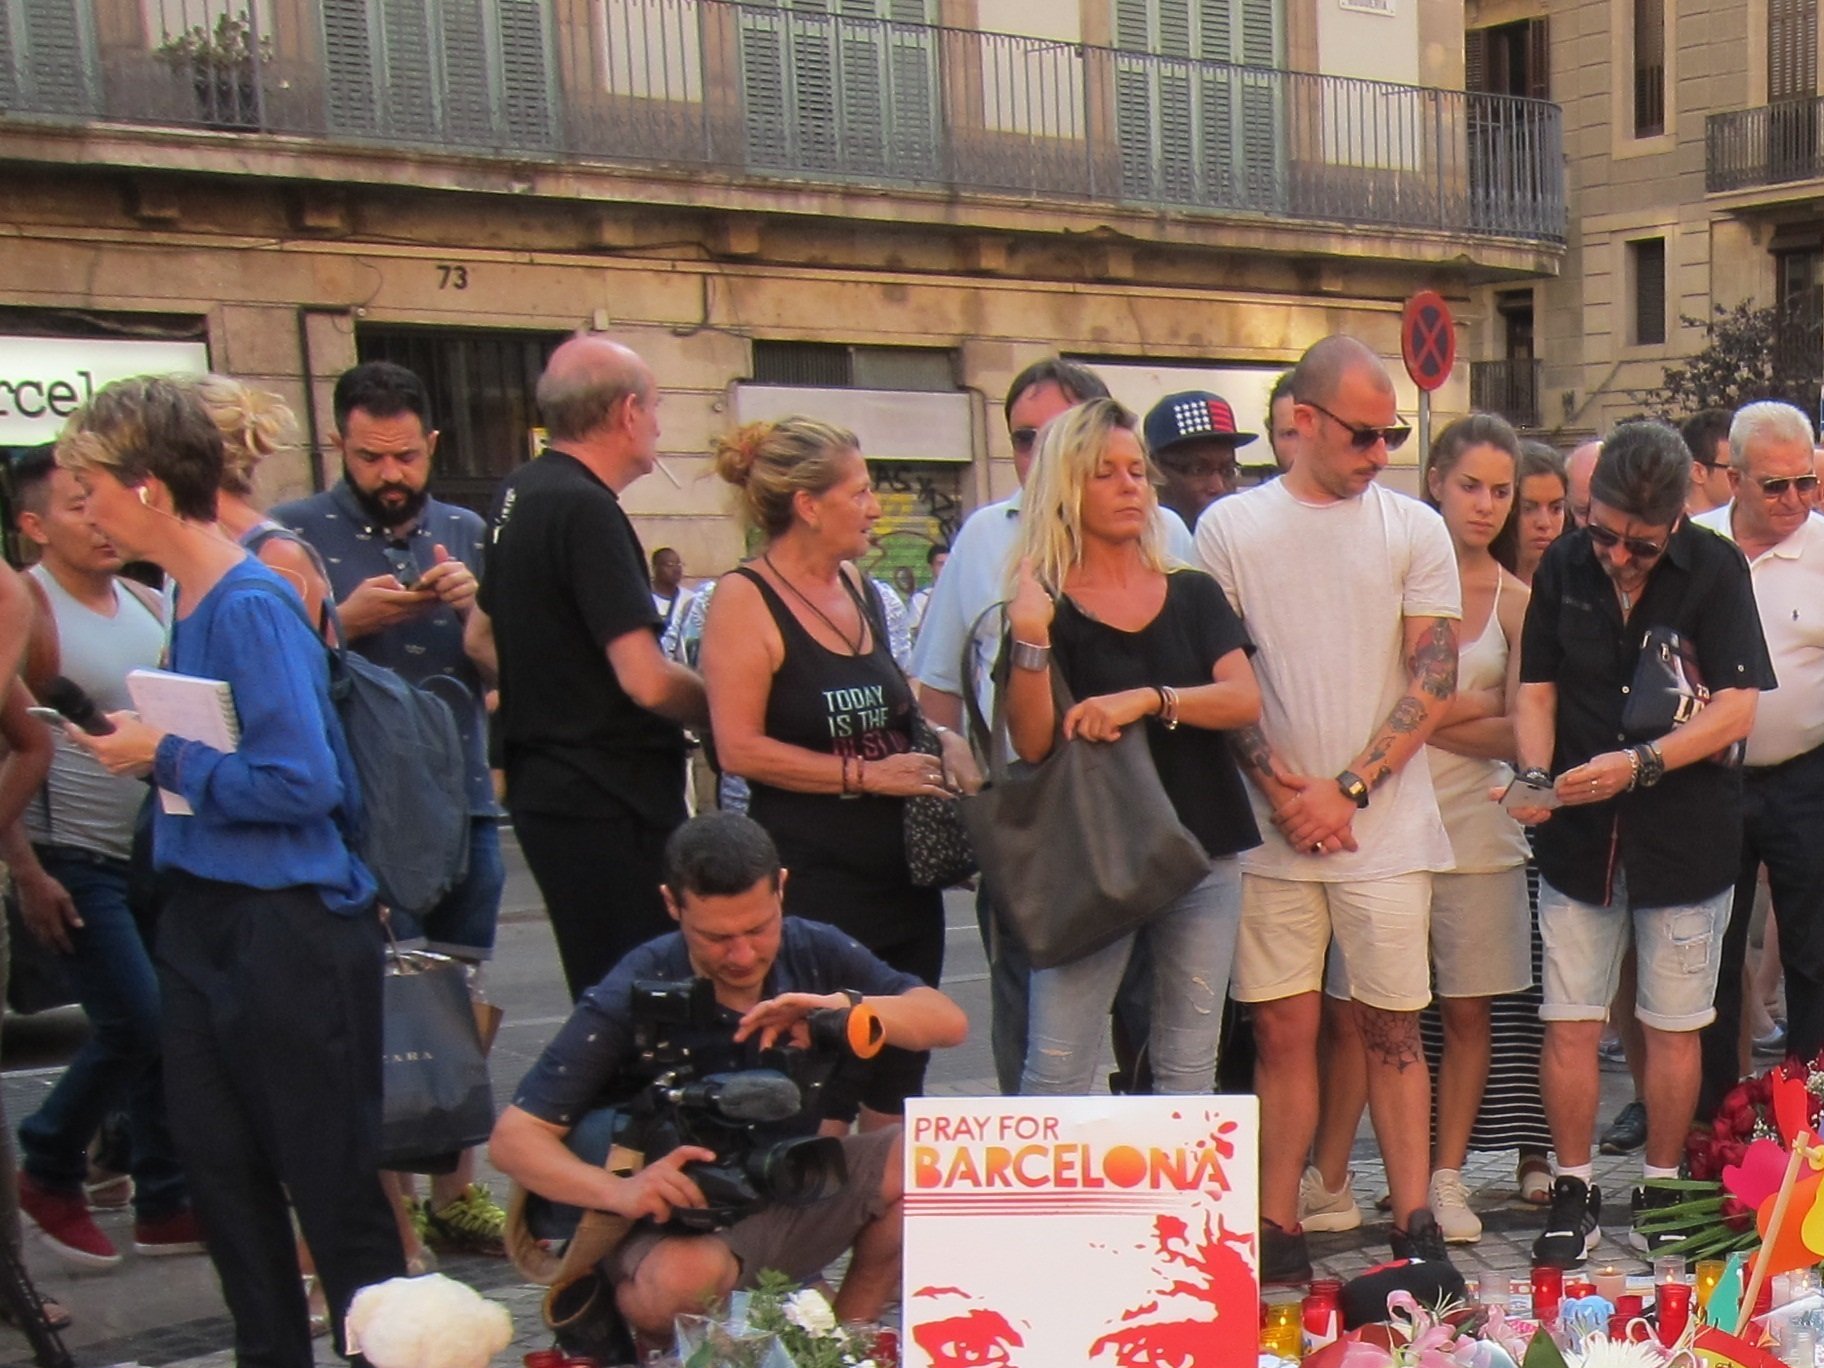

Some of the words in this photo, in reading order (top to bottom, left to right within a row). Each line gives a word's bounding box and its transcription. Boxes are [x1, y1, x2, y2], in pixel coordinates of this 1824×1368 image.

[436, 265, 467, 290] 73
[822, 685, 883, 713] TODAY
[827, 715, 853, 738] IS
[914, 1116, 991, 1142] PRAY
[998, 1116, 1060, 1142] FOR
[914, 1144, 1232, 1192] BARCELONA
